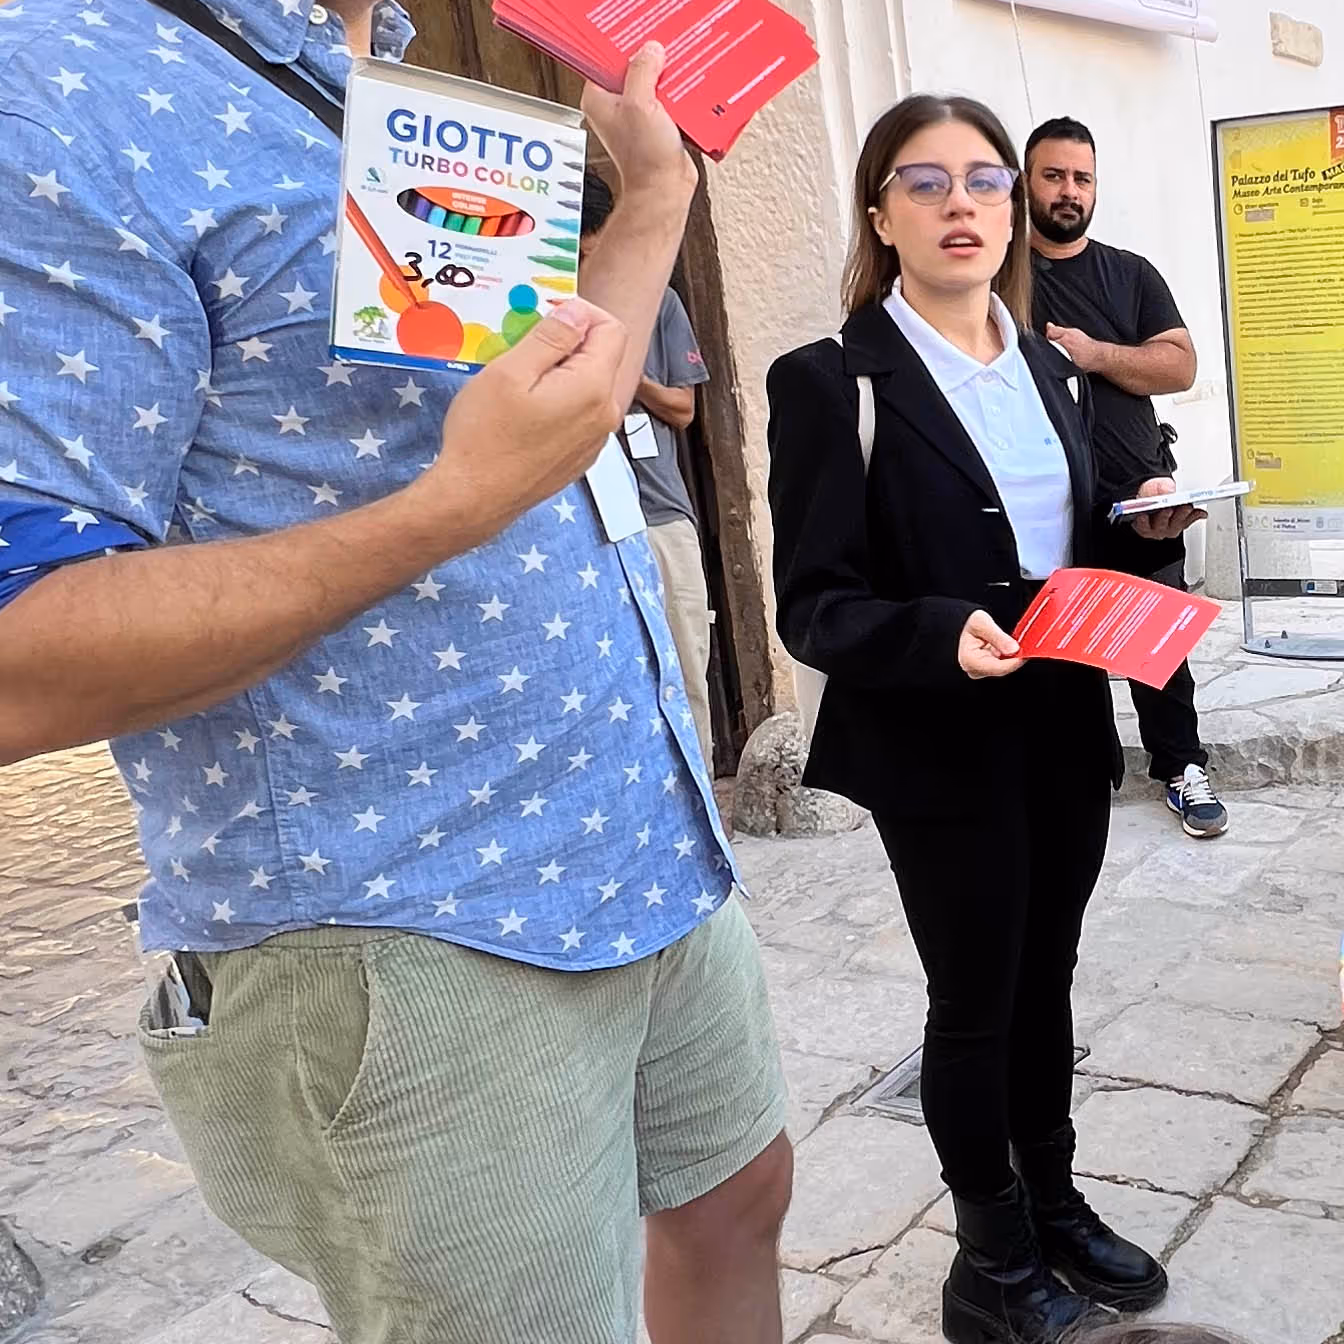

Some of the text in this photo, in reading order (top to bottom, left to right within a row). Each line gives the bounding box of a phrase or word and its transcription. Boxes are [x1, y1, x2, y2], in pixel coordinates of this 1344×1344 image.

[386, 108, 553, 172] GIOTTO
[388, 146, 550, 196] TURBO COLOR
[1231, 167, 1316, 187] Palazzo del Tufo
[1232, 189, 1260, 200] Museo
[1262, 186, 1282, 197] Arte
[428, 239, 453, 260] 12
